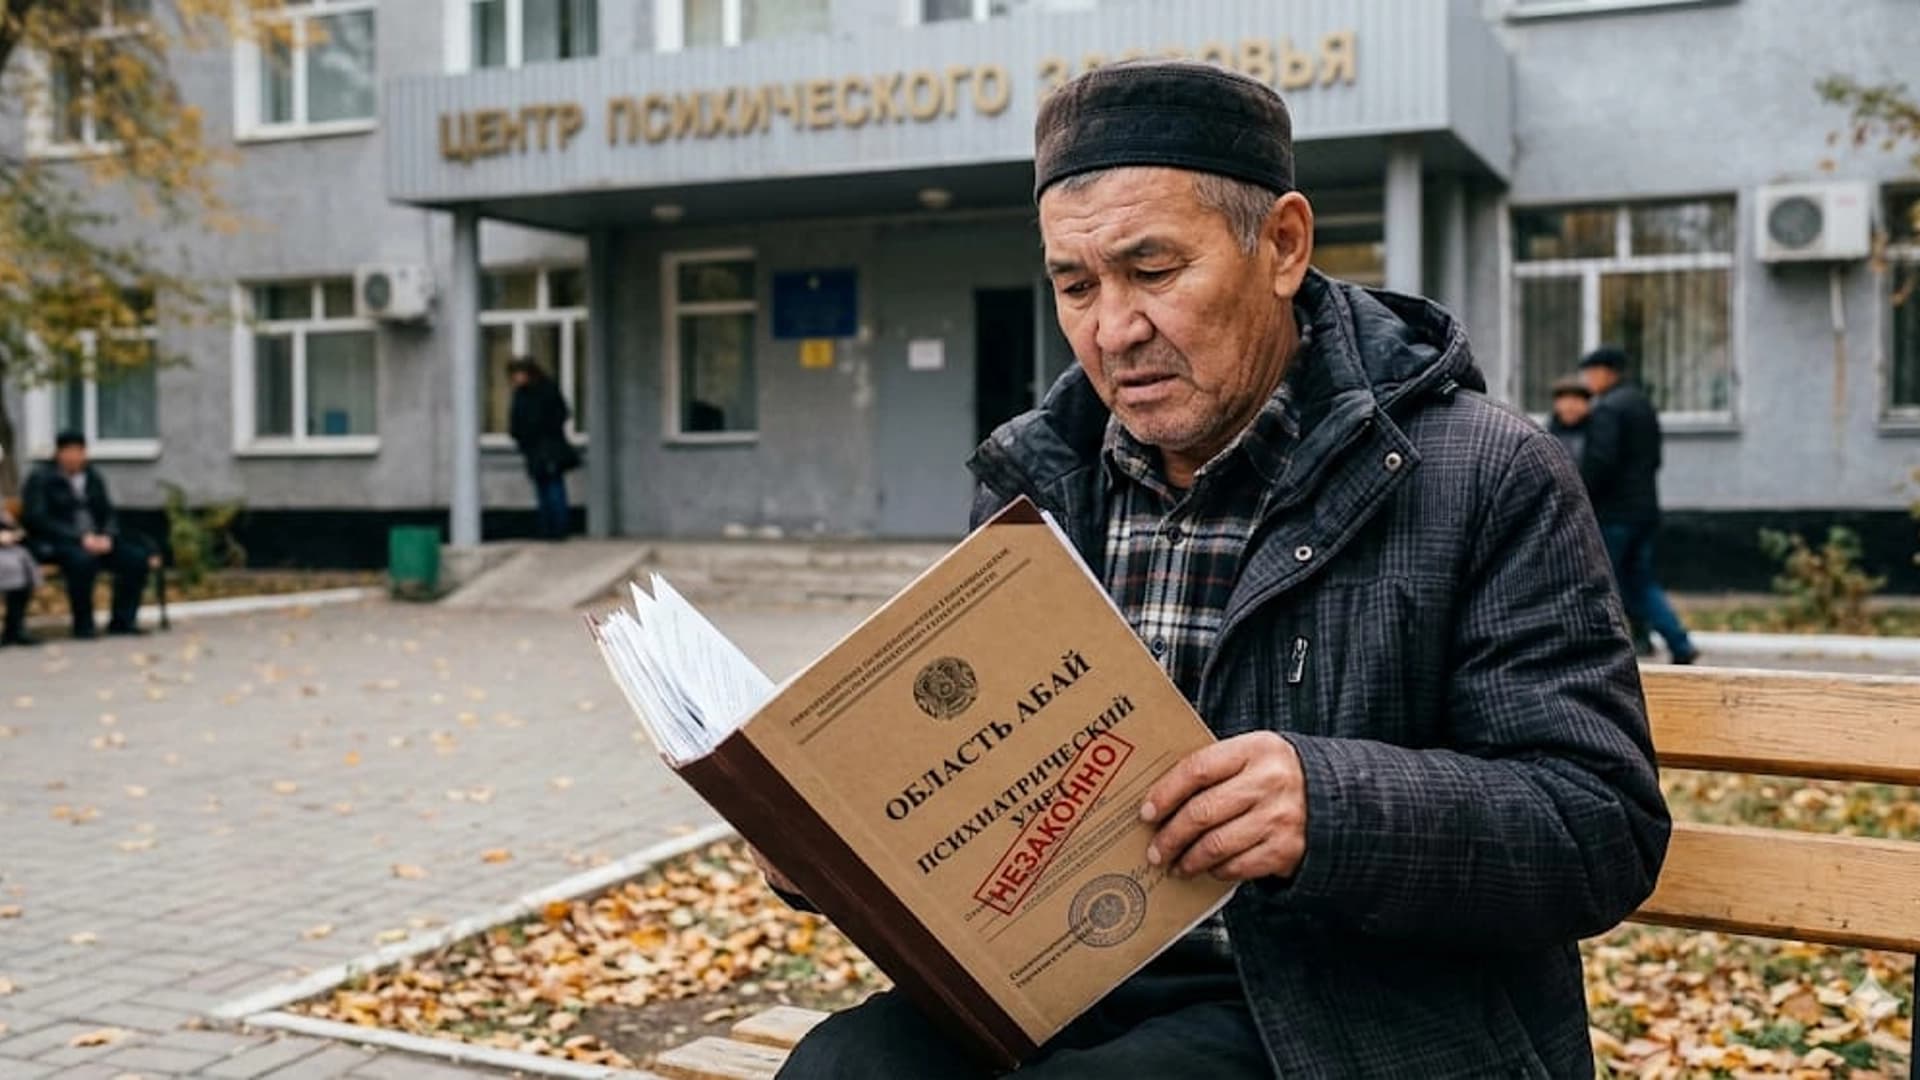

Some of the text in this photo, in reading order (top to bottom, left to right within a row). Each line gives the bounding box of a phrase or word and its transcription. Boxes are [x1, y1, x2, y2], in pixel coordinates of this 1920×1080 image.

[438, 31, 1356, 163] ЦЕНТР ПСИХИЧЕСКОГО ЗВЬЯ
[885, 649, 1092, 821] ОБЛАСТЬ АБАЙ
[916, 695, 1136, 875] ПСИХИАТРИЧЕСКИЙ
[989, 744, 1119, 902] НЕЗАКОННО
